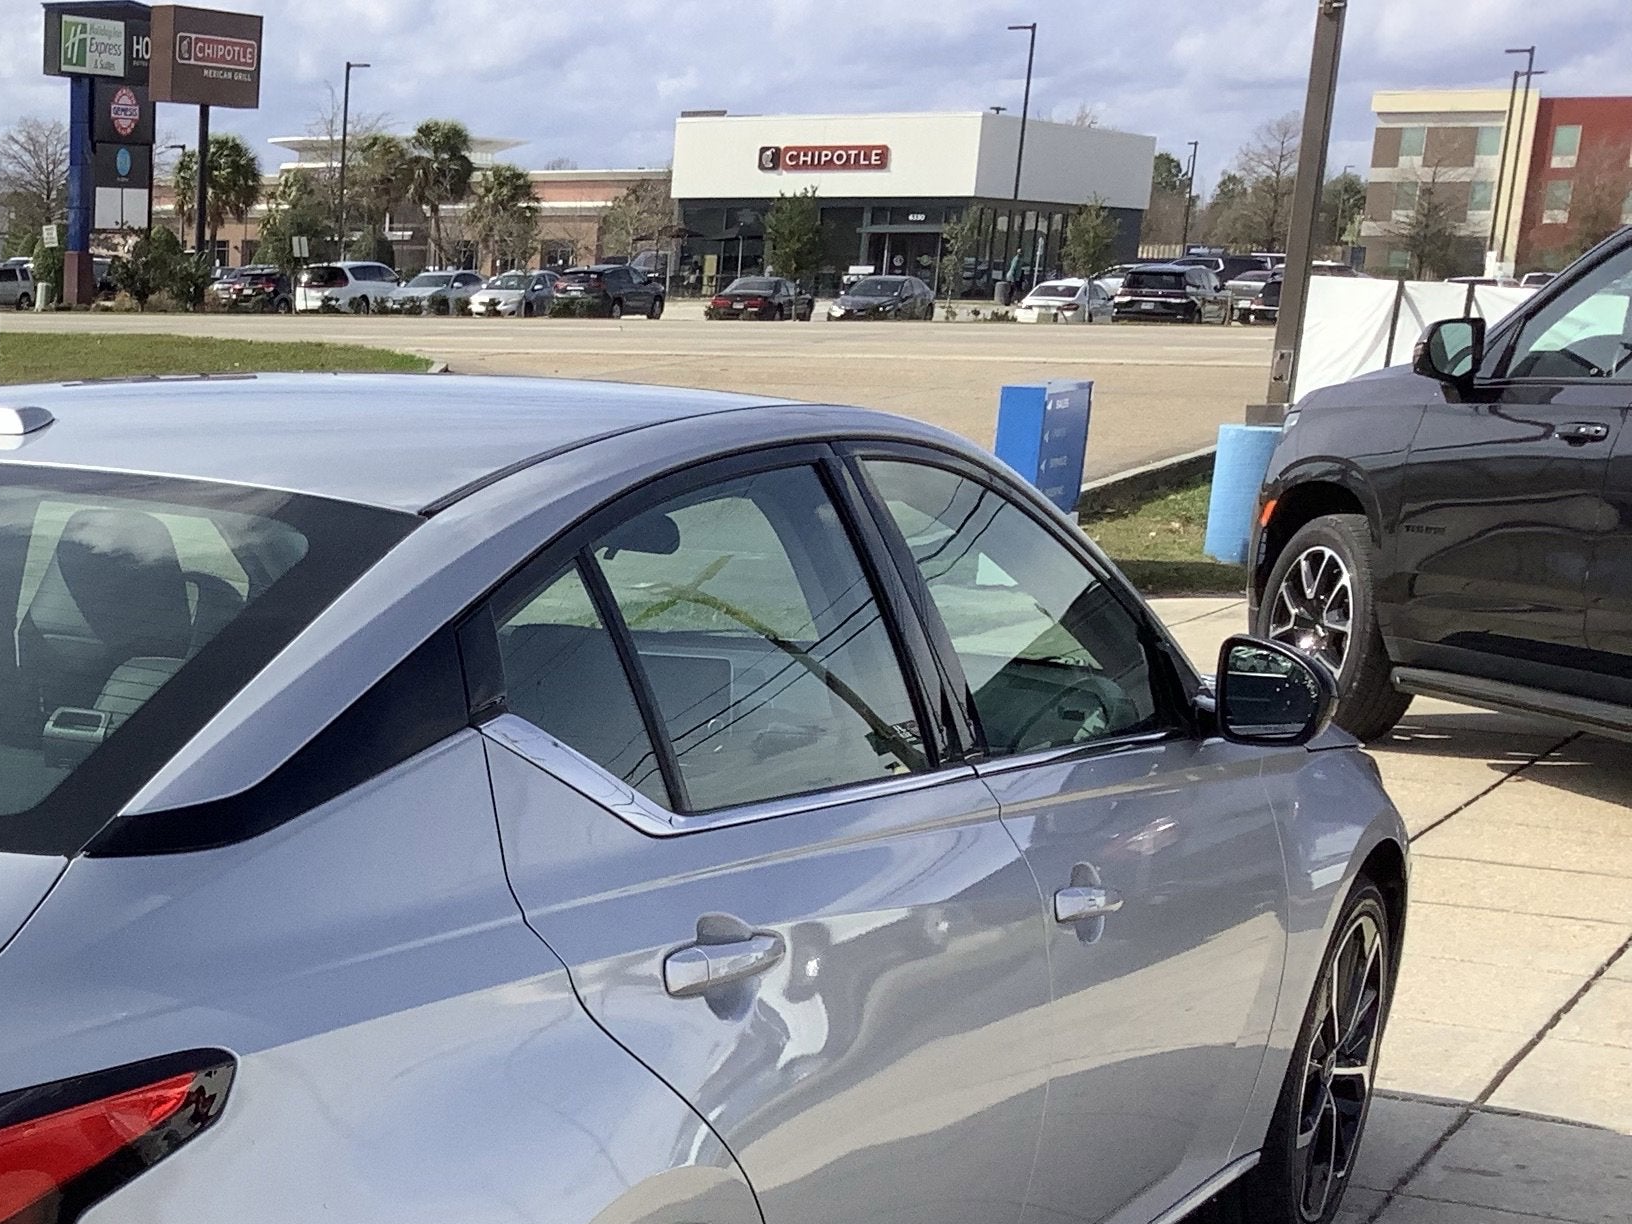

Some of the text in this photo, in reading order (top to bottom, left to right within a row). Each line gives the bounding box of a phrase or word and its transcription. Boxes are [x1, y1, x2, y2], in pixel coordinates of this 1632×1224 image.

[89, 37, 122, 58] Express
[196, 42, 254, 63] CHIPOTLE
[203, 68, 252, 82] MEXICAN GRILL
[112, 105, 139, 117] GENESIS
[785, 150, 882, 165] CHIPOTLE
